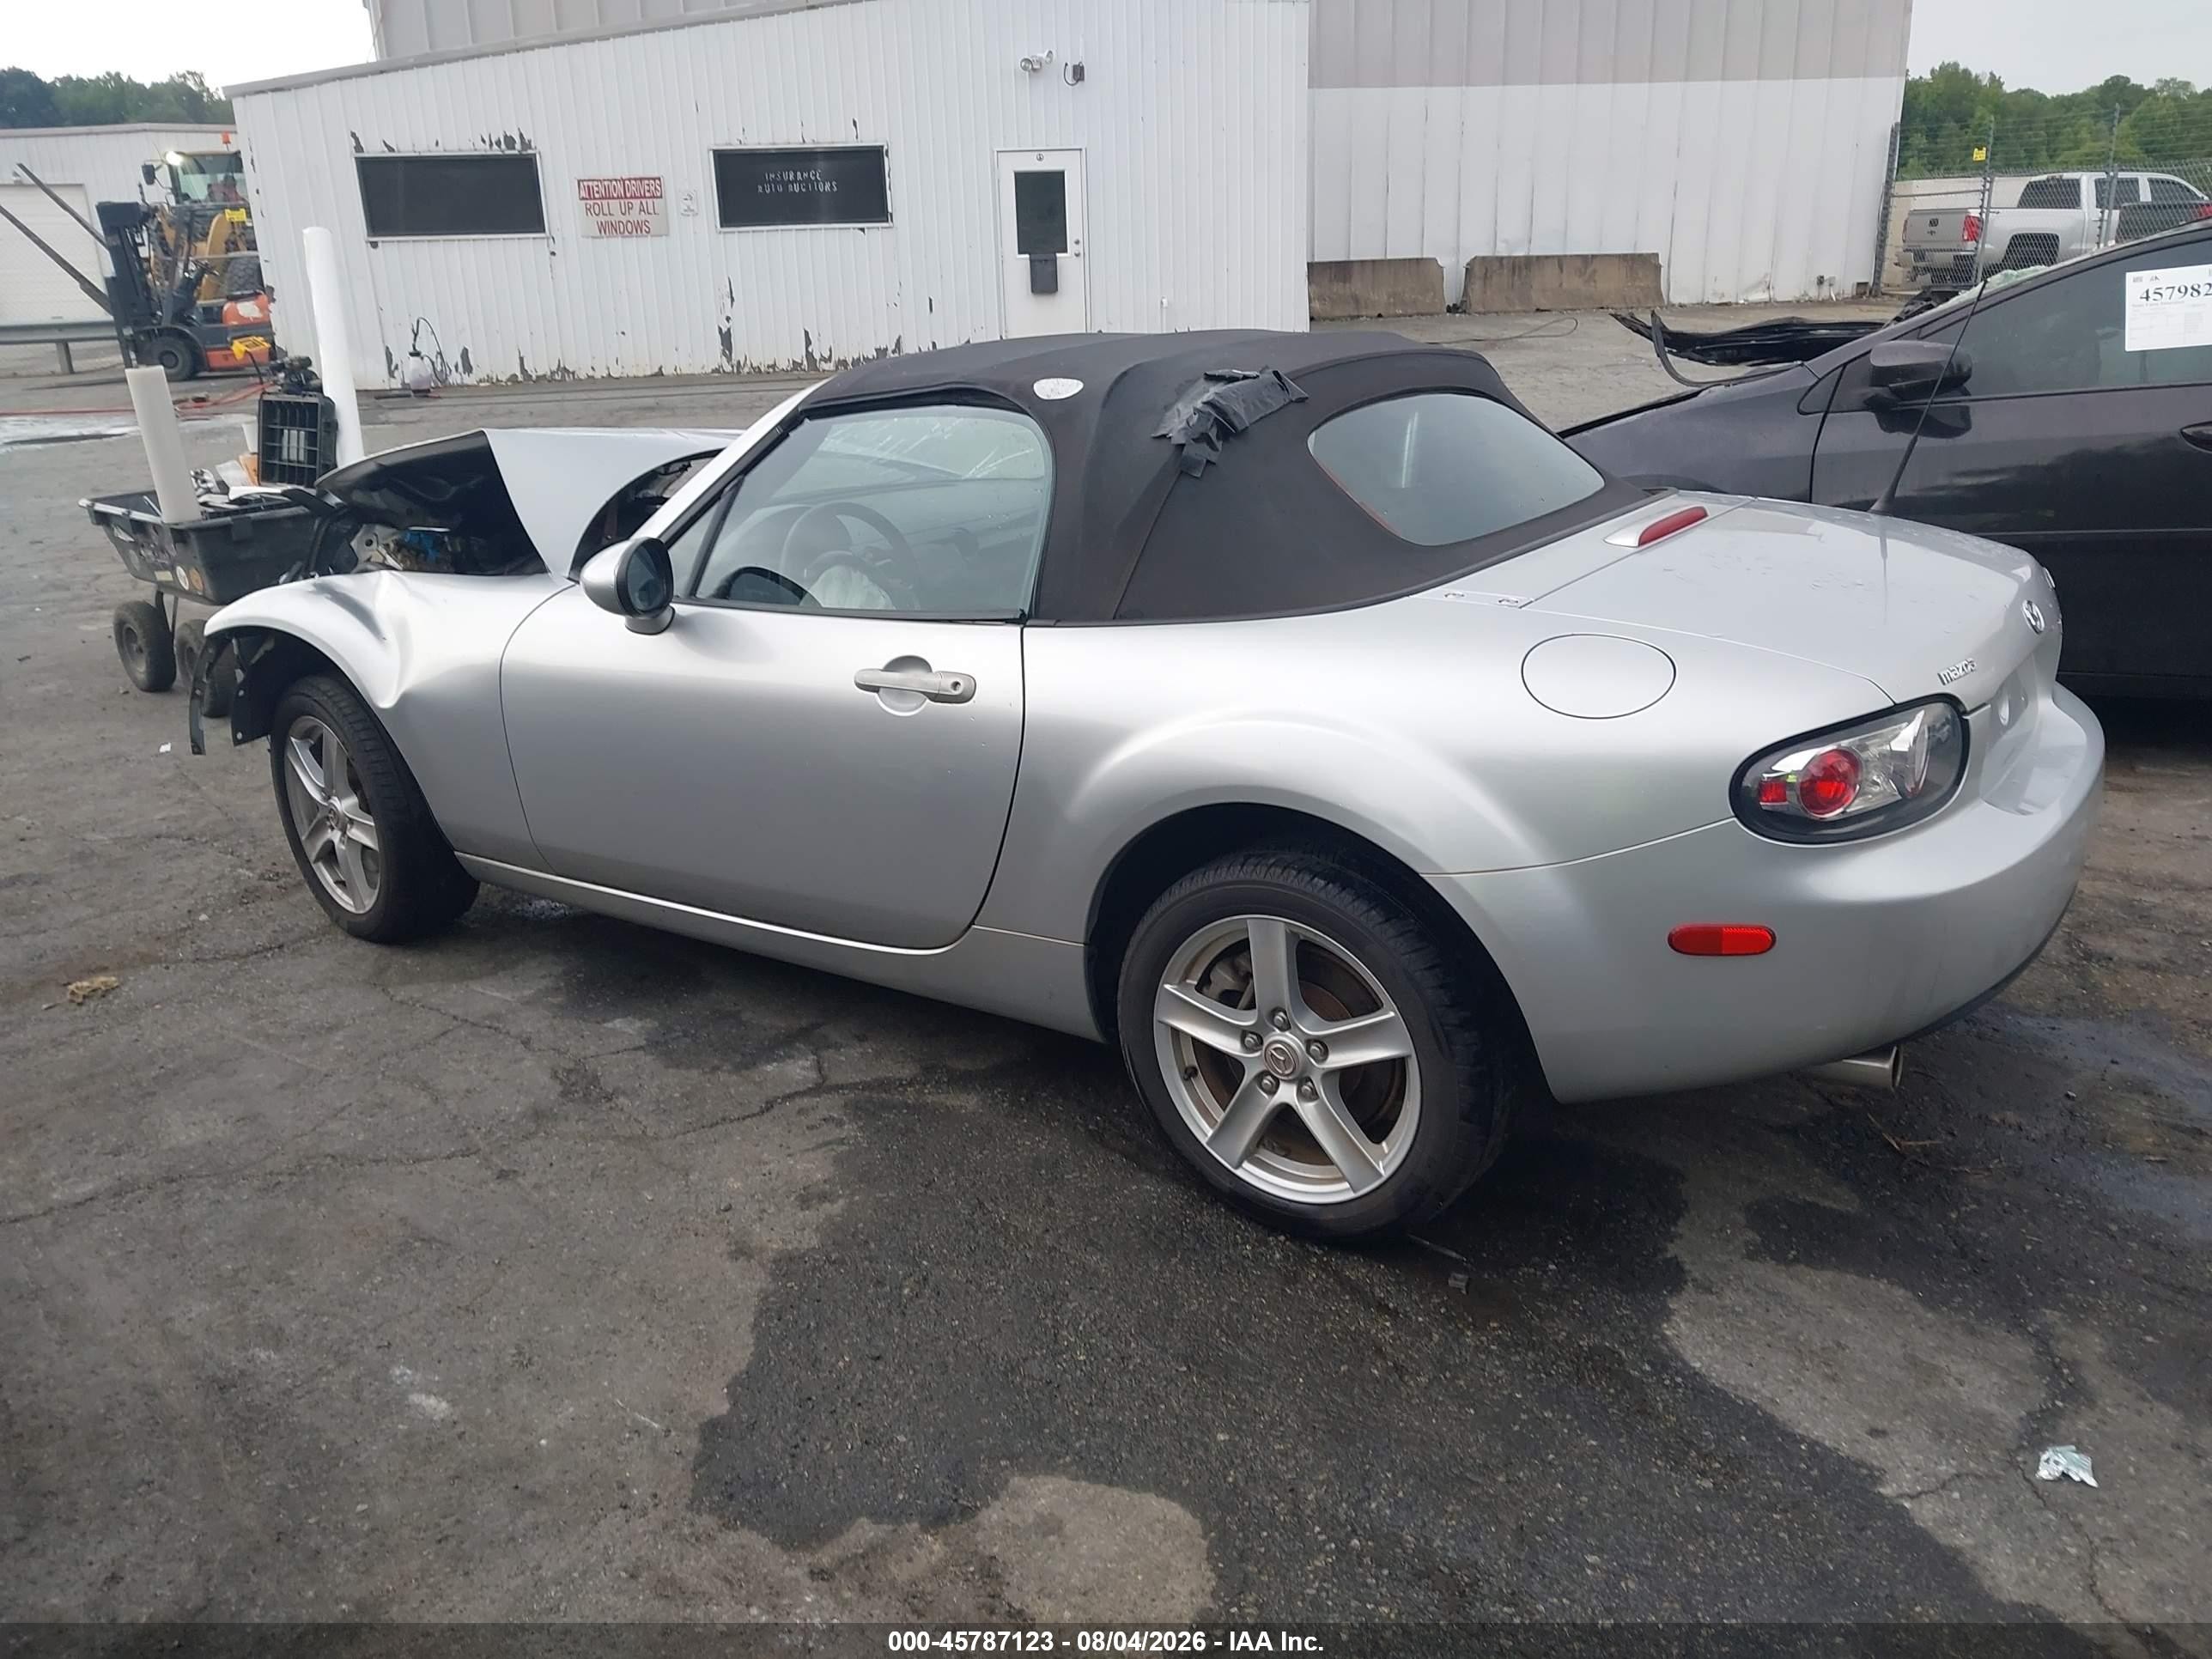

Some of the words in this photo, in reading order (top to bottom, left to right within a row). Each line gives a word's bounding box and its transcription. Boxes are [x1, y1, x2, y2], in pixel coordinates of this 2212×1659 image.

[765, 169, 822, 181] INSURANCE
[579, 179, 624, 199] ATTENTION
[624, 178, 661, 198] DRIVERS
[585, 202, 614, 216] ROLL
[619, 202, 634, 216] UP
[639, 201, 659, 216] ALL
[597, 220, 651, 235] WINDOWS
[2139, 283, 2212, 301] 457982
